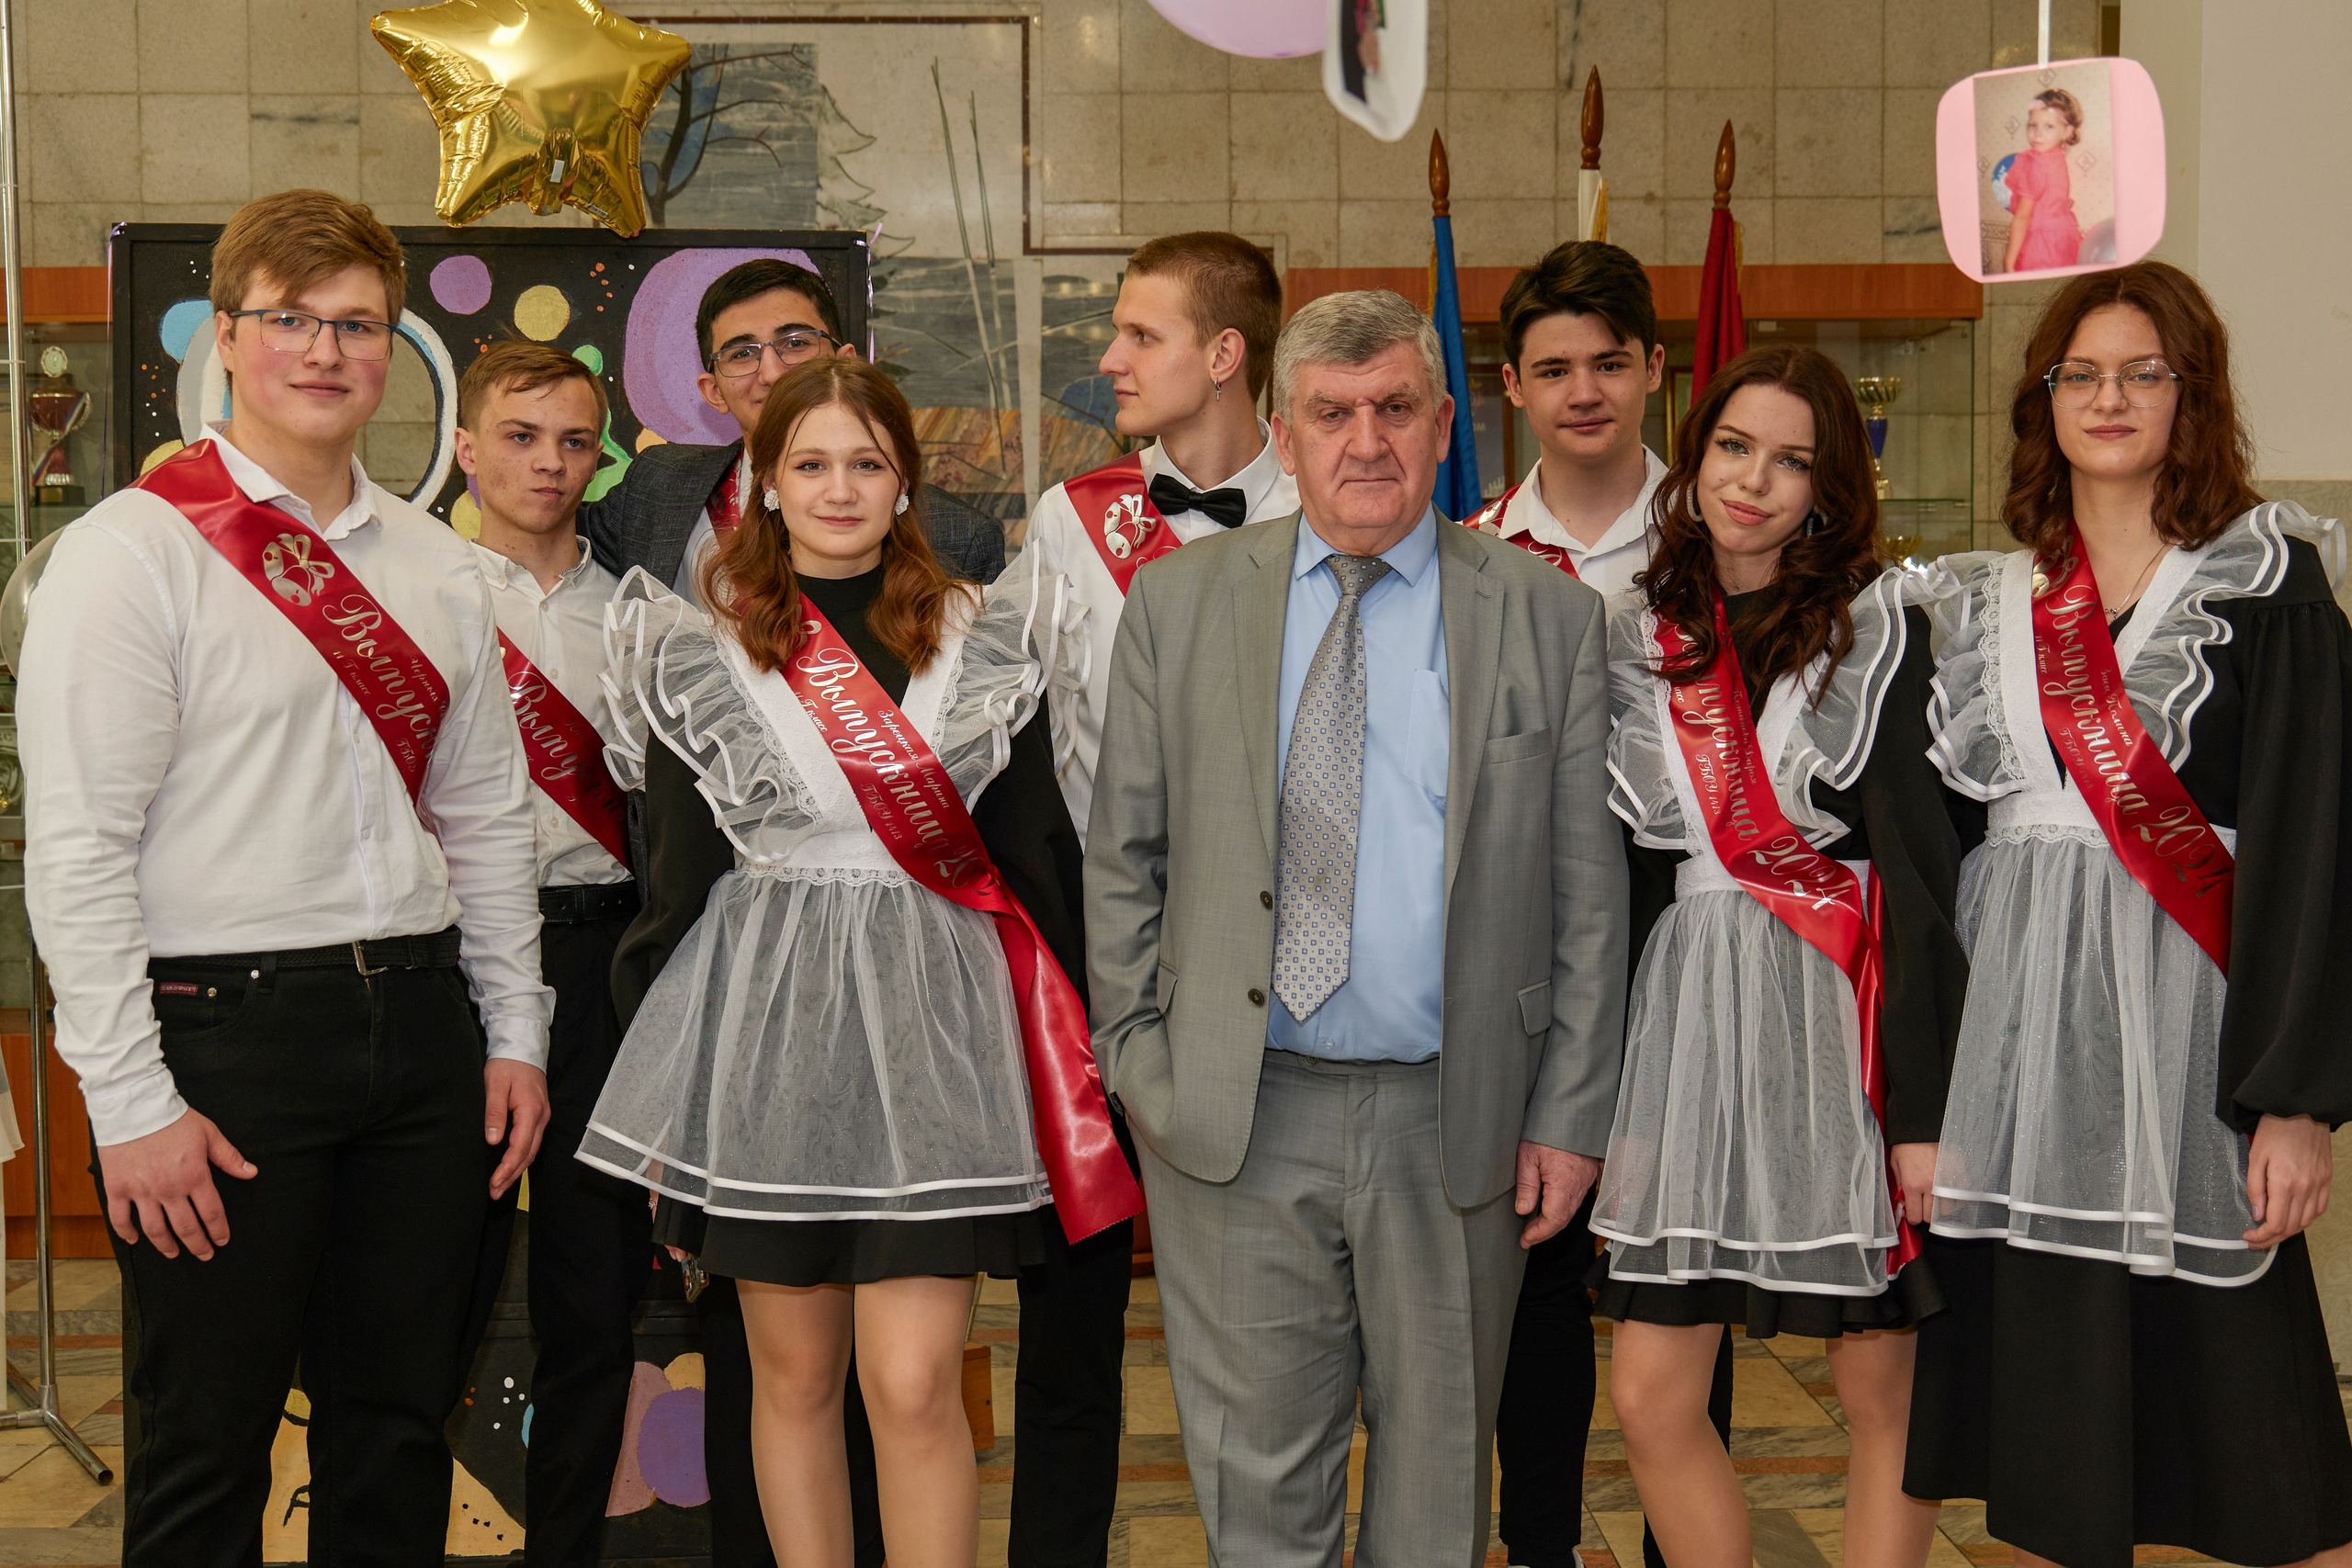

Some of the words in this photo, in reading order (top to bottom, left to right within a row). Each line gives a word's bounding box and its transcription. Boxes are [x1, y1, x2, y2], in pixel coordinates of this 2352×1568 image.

[350, 672, 371, 695] класс
[2038, 654, 2048, 674] класс
[796, 648, 949, 852] Выпускница
[2043, 584, 2149, 816] Выпускница
[2132, 806, 2231, 898] 2024
[2057, 727, 2085, 766] ГБОУ
[2106, 694, 2134, 747] Полина
[878, 709, 919, 761] Зарецкая
[916, 762, 950, 808] Марина
[1695, 754, 1718, 793] ГБОУ
[1709, 796, 1721, 815] 1413
[860, 783, 894, 819] ГБОУ
[885, 822, 903, 840] 1413
[1747, 836, 1857, 910] 2024
